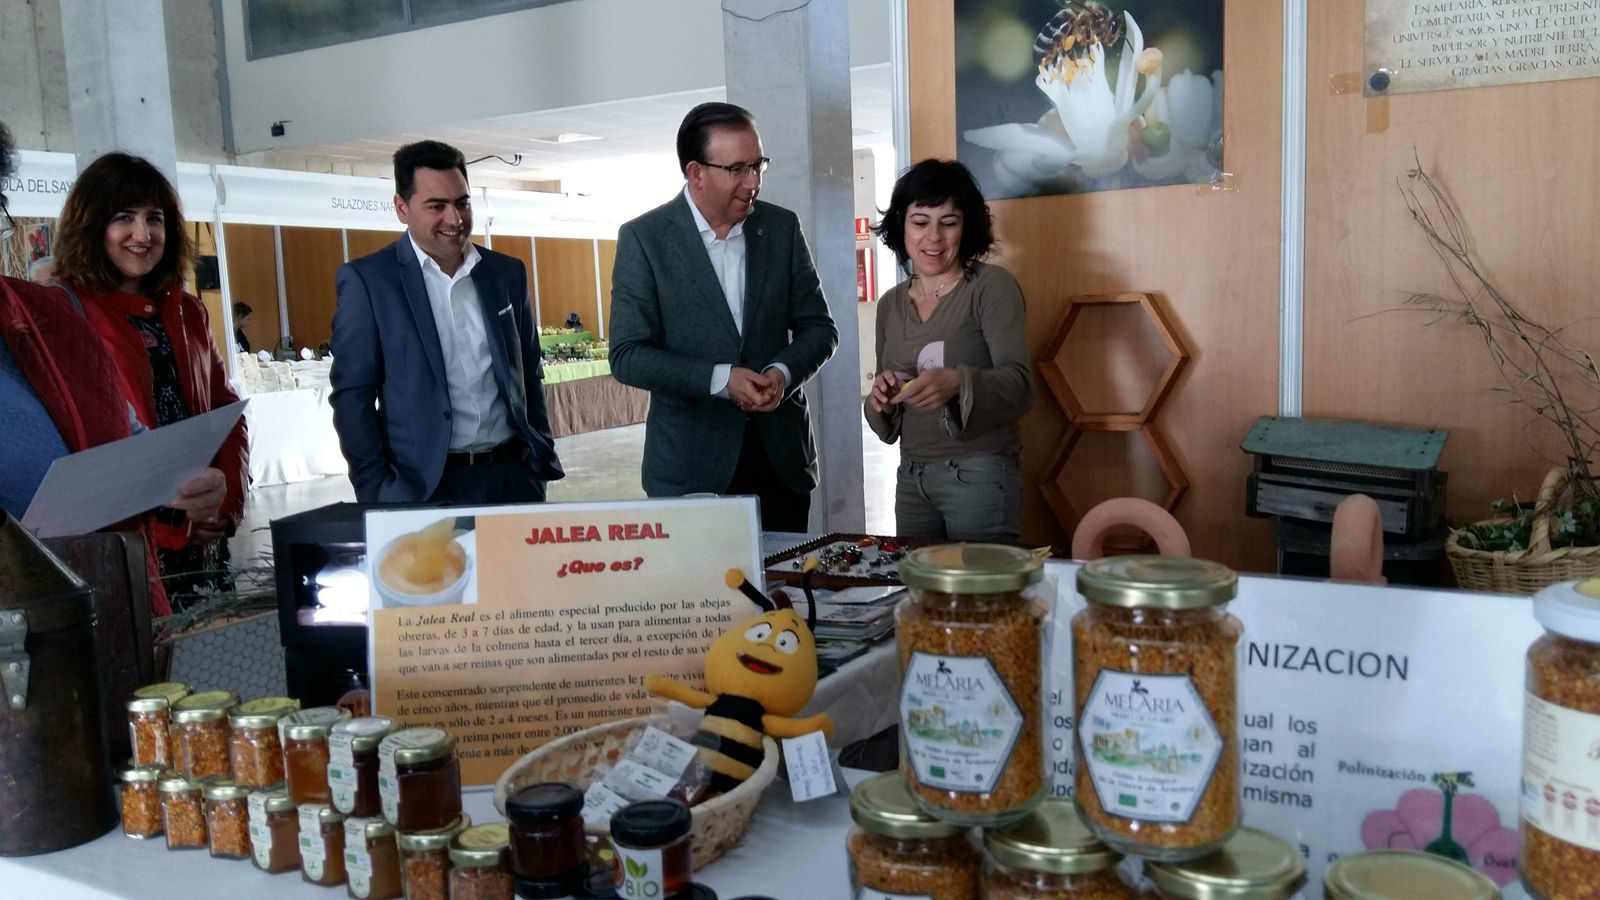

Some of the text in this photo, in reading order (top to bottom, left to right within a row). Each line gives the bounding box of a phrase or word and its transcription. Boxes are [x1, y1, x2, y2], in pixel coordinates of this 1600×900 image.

[1411, 12, 1492, 28] COMUNITARIA
[1511, 6, 1541, 18] HACE
[1414, 4, 1430, 15] EN
[1456, 25, 1496, 36] SOMOS
[1553, 15, 1597, 26] CULTO
[1432, 39, 1488, 53] IMPULSOR
[1504, 31, 1565, 46] NUTRIENTE
[1572, 29, 1587, 39] DE
[1418, 54, 1468, 67] SERVICIO
[1505, 46, 1545, 59] MADRE
[331, 197, 379, 212] SALAZONES
[525, 522, 670, 545] JALEA REAL
[556, 556, 644, 578] ¿Que es?
[398, 598, 731, 627] La Jalea Real es el alimento especial producido por las abejas
[444, 628, 457, 640] de
[461, 628, 469, 639] 3
[472, 630, 478, 638] a
[482, 626, 489, 636] 7
[493, 624, 514, 636] días
[518, 623, 531, 635] de
[566, 623, 573, 634] y
[578, 620, 587, 631] la
[591, 620, 615, 630] usan
[618, 618, 641, 631] para
[644, 614, 691, 628] alimentar
[695, 615, 702, 624] a
[705, 612, 732, 624] todas
[399, 646, 414, 658] las
[418, 644, 450, 657] larvas
[454, 643, 467, 654] de
[472, 642, 482, 653] la
[486, 640, 530, 652] colmena
[534, 637, 561, 649] hasta
[565, 635, 575, 646] el
[579, 633, 609, 645] tercer
[636, 634, 643, 642] a
[646, 628, 698, 643] excepción
[701, 627, 714, 638] de
[399, 663, 418, 677] que
[421, 662, 441, 673] van
[443, 663, 450, 671] a
[452, 661, 468, 671] ser
[470, 658, 502, 670] reinas
[505, 658, 524, 670] que
[526, 656, 546, 666] son
[548, 650, 609, 664] alimentadas
[612, 650, 629, 662] por
[632, 648, 642, 659] el
[644, 647, 669, 658] resto
[671, 645, 684, 656] de
[687, 645, 698, 655] su
[1248, 641, 1409, 681] NIZACION
[397, 688, 421, 700] Este
[422, 685, 487, 699] concentrado
[489, 682, 556, 697] sorprendente
[559, 679, 572, 691] de
[574, 675, 626, 689] nutrientes
[628, 674, 638, 685] le
[916, 670, 985, 692] MELARIA
[397, 704, 410, 716] de
[413, 703, 442, 715] cinco
[475, 698, 520, 711] mientras
[522, 699, 541, 711] que
[544, 695, 554, 706] el
[557, 691, 606, 707] promedio
[609, 690, 622, 701] de
[625, 688, 647, 700] vida
[1104, 691, 1185, 713] MELARIA
[449, 716, 471, 728] sólo
[473, 715, 486, 726] de
[489, 714, 496, 725] 2
[498, 715, 505, 724] a
[507, 713, 514, 723] 4
[555, 710, 568, 721] Es
[571, 710, 584, 720] un
[587, 706, 633, 718] nutriente
[636, 705, 652, 715] tan
[1287, 713, 1318, 735] los
[463, 731, 491, 743] reina
[491, 730, 521, 744] poner
[524, 727, 551, 739] entre
[493, 745, 514, 757] más
[517, 743, 530, 755] de
[1297, 741, 1315, 759] al
[1243, 785, 1313, 809] misma
[625, 879, 660, 898] BIO
